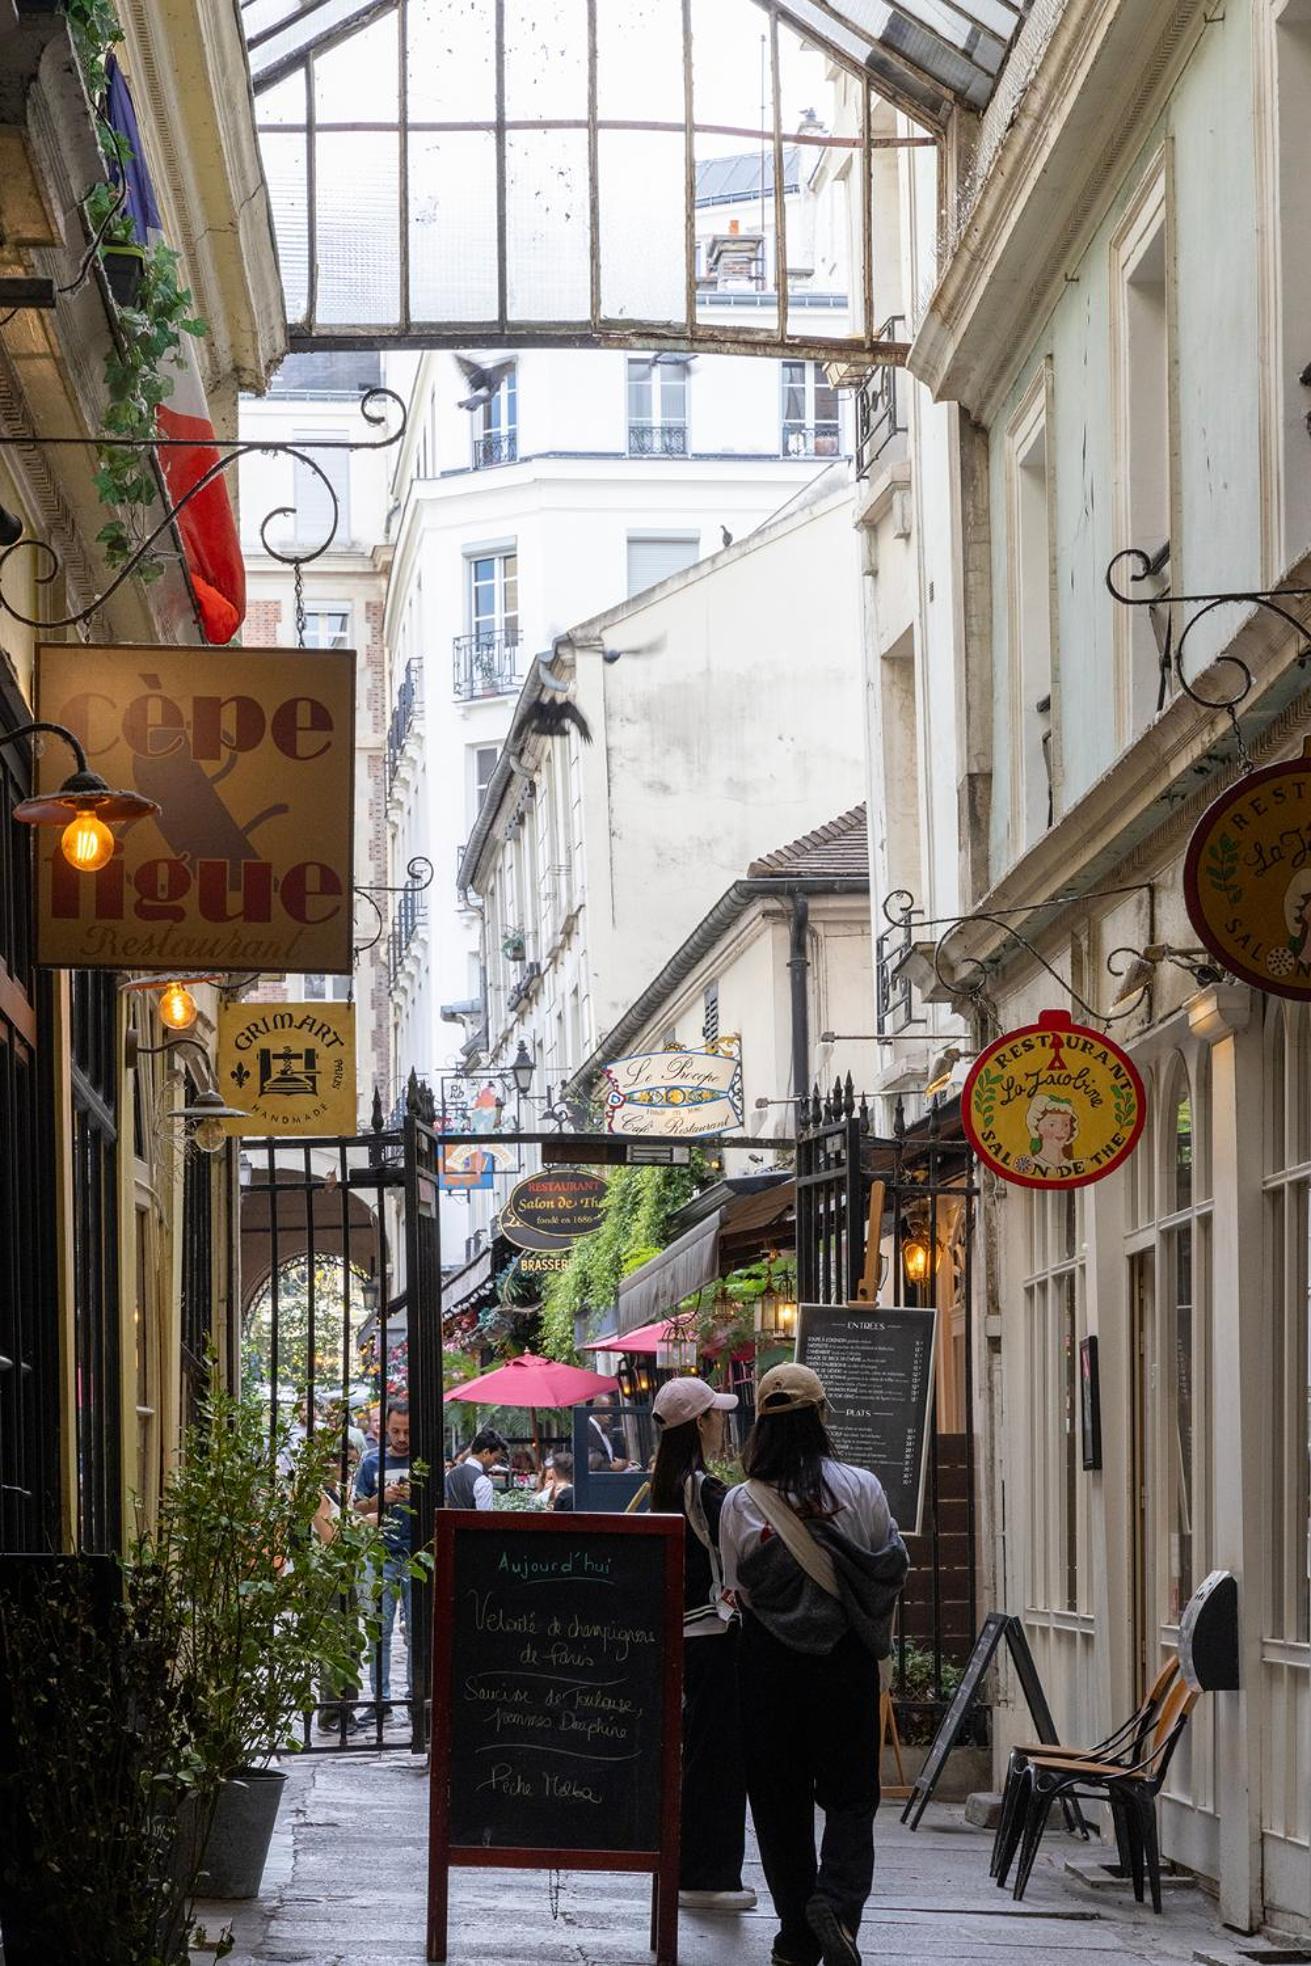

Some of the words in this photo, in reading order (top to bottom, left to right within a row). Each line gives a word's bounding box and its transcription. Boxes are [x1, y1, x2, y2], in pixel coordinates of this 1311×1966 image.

[58, 673, 335, 761] cèpe
[1230, 781, 1307, 830] REST
[79, 923, 315, 960] Restaurant
[234, 1012, 345, 1052] GRIMART
[661, 1055, 720, 1088] Procope
[1000, 1075, 1026, 1106] La
[1024, 1067, 1103, 1108] Jacobine
[251, 1102, 330, 1125] HANDMADE
[660, 1114, 731, 1135] Restaurant
[1057, 1160, 1085, 1178] DE
[1090, 1132, 1126, 1165] THE
[528, 1182, 600, 1194] RESTAURANT
[518, 1196, 555, 1212] Salon
[558, 1196, 578, 1209] de
[521, 1259, 570, 1271] BRASSER
[499, 1552, 611, 1577] Aujourd'hui
[520, 1642, 539, 1665] de
[543, 1642, 594, 1666] Paris
